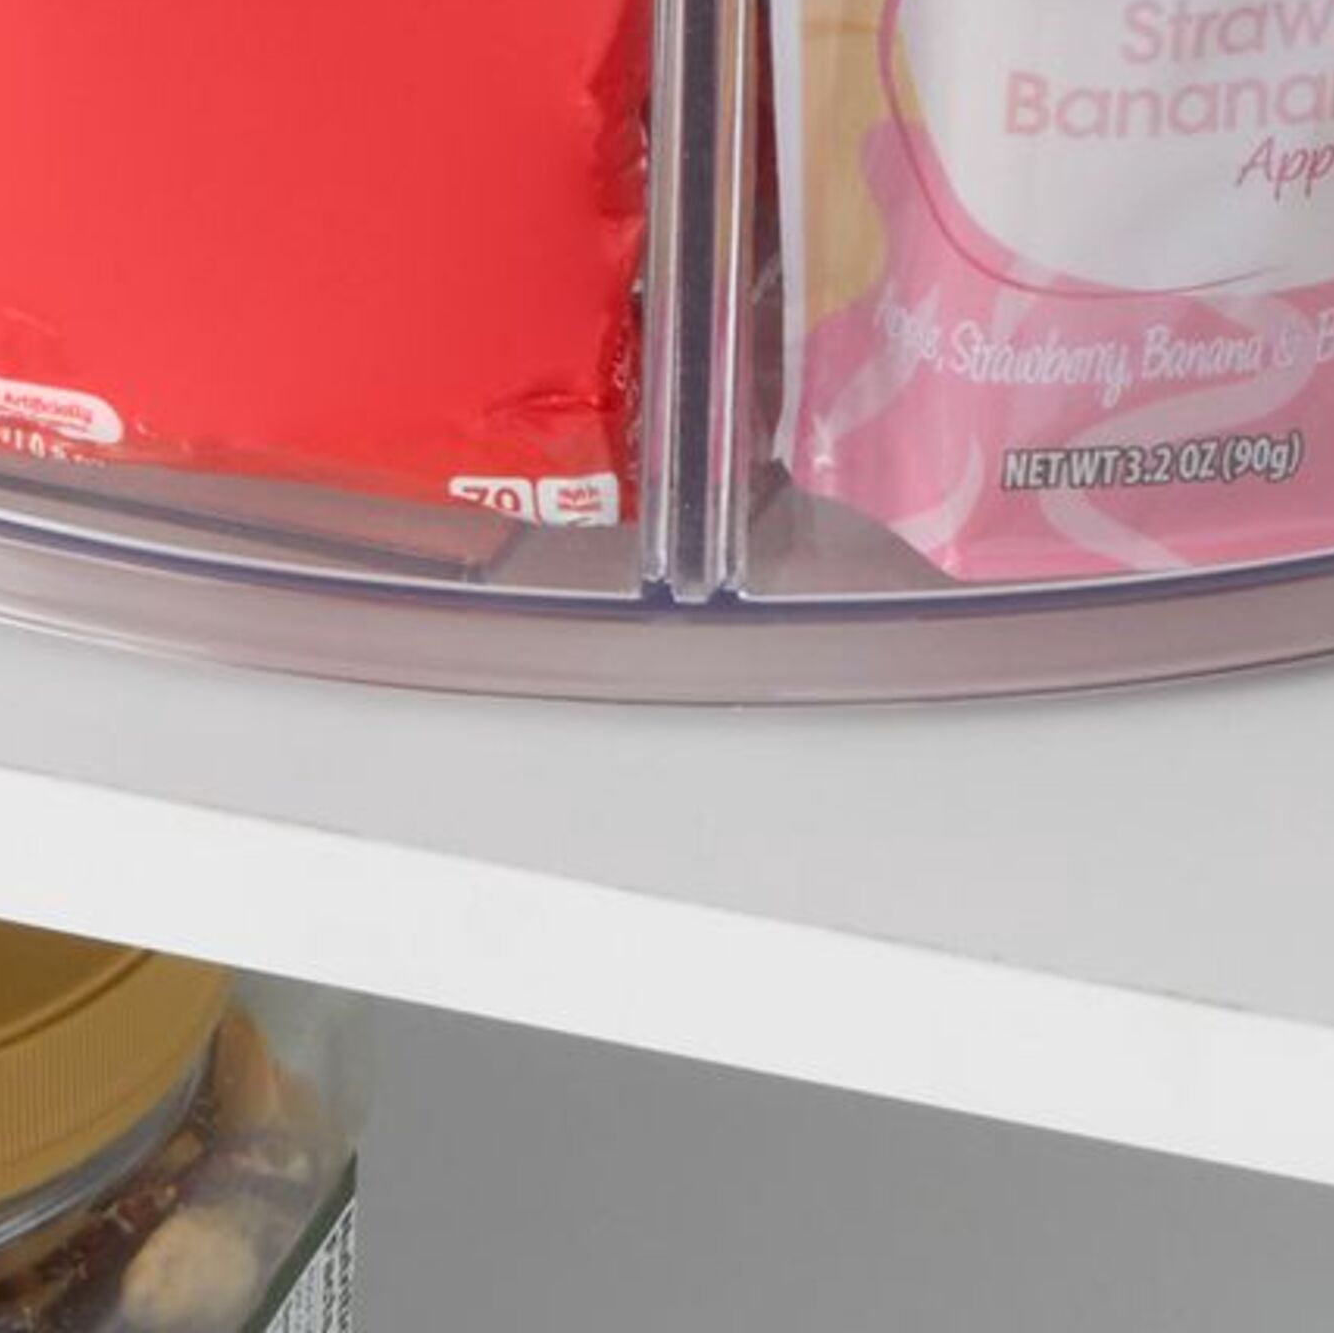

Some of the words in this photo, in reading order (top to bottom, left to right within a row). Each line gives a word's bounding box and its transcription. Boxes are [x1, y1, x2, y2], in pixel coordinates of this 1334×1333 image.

[1140, 323, 1264, 381] Banana
[1002, 449, 1066, 493] NET
[1067, 447, 1123, 490] WT
[1123, 444, 1171, 486] 3.2
[1176, 438, 1220, 482] OZ
[1221, 429, 1305, 484] (90g)
